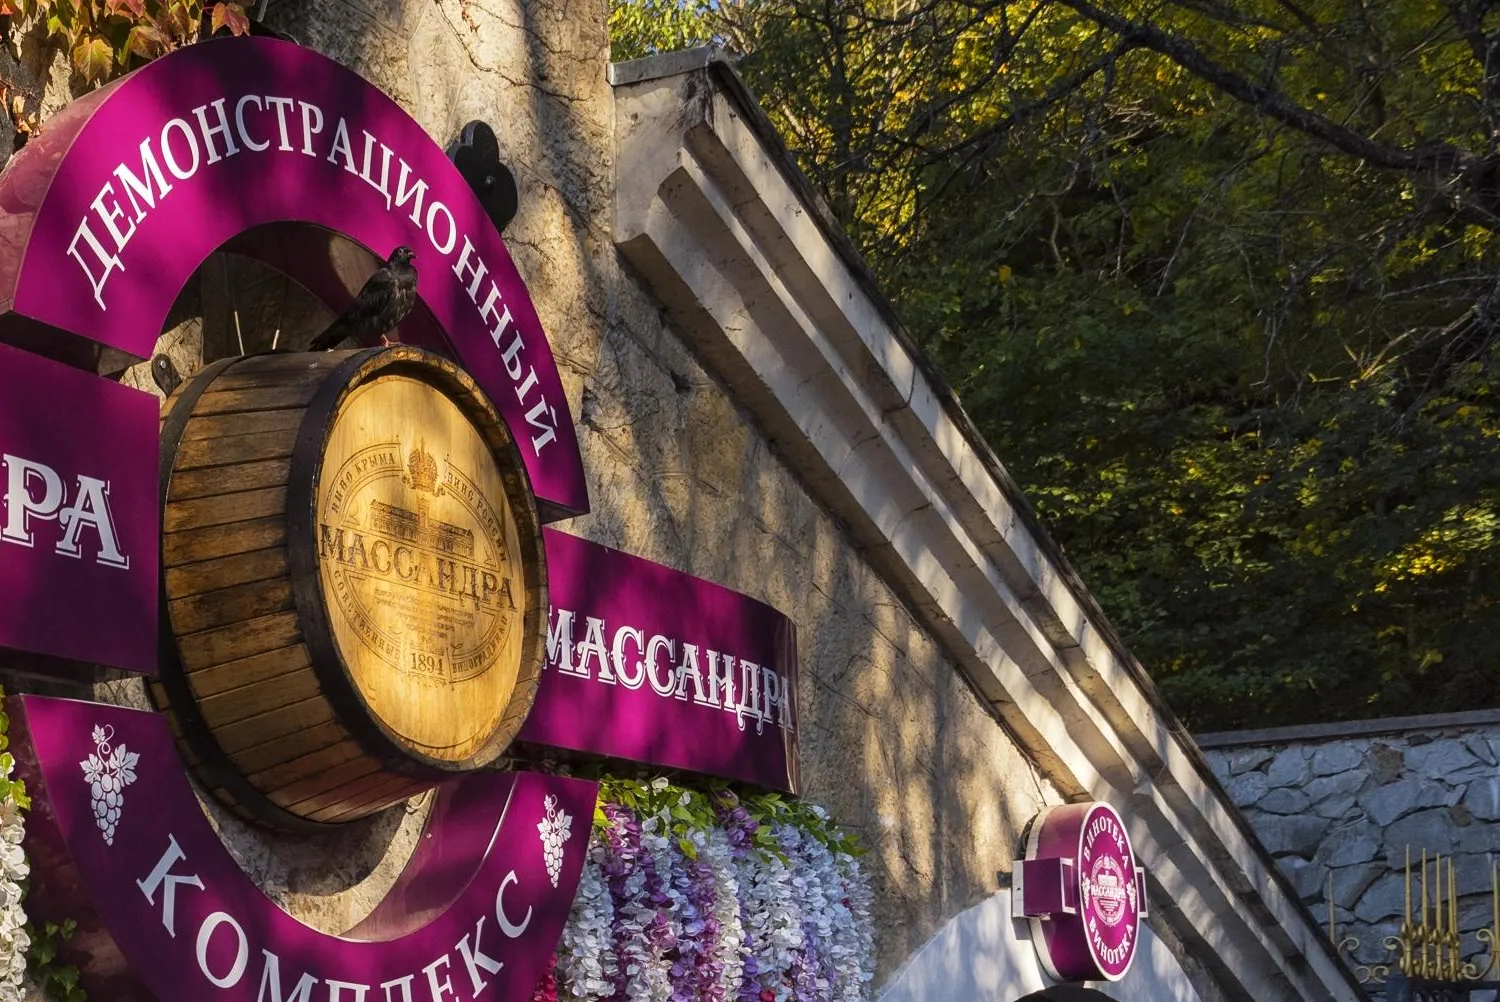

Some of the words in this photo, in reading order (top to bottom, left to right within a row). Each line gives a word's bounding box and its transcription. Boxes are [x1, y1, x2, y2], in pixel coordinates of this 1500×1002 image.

[66, 94, 557, 457] ДЕМОНСТРАЦИОННЫЙ
[331, 471, 353, 514] ВИНО
[355, 453, 396, 475] КРЫМА
[447, 471, 474, 502] ВИНО
[476, 498, 507, 563] РОССИИ
[319, 523, 518, 611] МАССАНДРА
[411, 652, 445, 676] 1894
[1084, 816, 1129, 869] ВИНОТЕКА
[1089, 918, 1134, 965] ВИНОТЕКА
